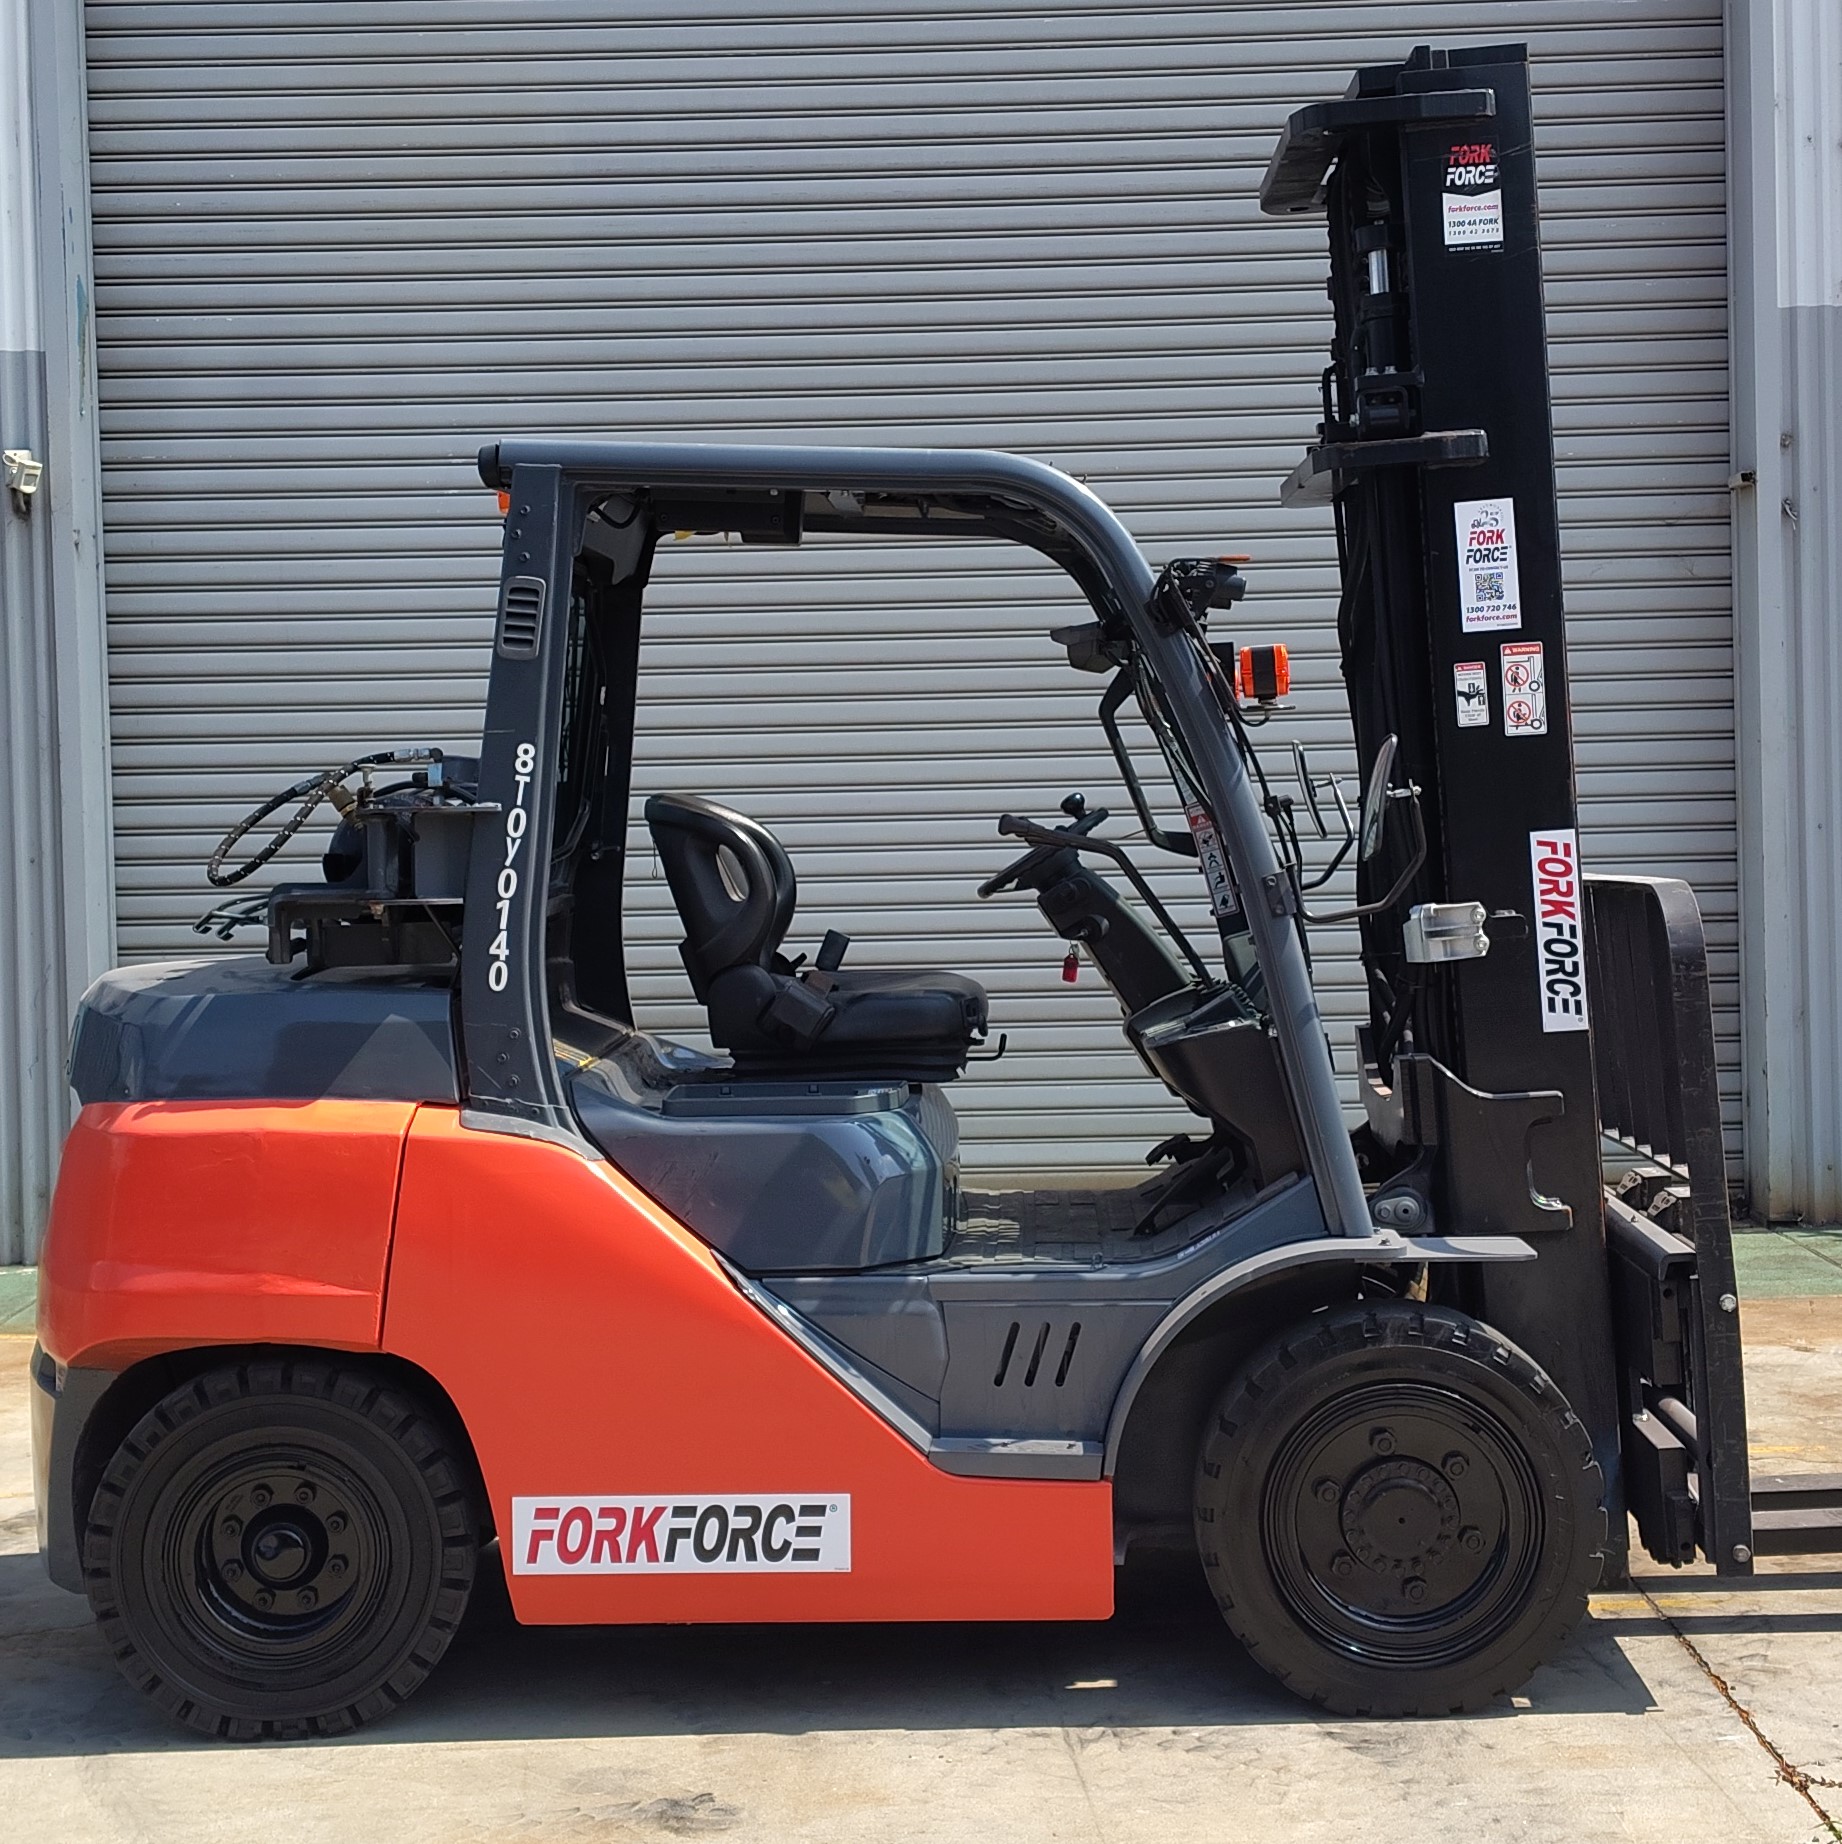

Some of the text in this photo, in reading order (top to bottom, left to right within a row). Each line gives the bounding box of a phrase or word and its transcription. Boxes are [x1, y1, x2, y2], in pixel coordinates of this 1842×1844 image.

[1449, 144, 1492, 165] FORK
[1445, 164, 1497, 187] FORCE
[1447, 204, 1499, 213] forkforce.com
[1448, 220, 1466, 228] 1300
[1478, 217, 1500, 226] FORK
[1468, 528, 1506, 547] FORK
[1465, 545, 1509, 565] FORCE
[1465, 613, 1518, 623] forkforce.com
[1466, 603, 1517, 614] 1300 720 746
[1536, 839, 1583, 1016] FORKFORCE
[526, 1503, 828, 1564] FORKFORCE
